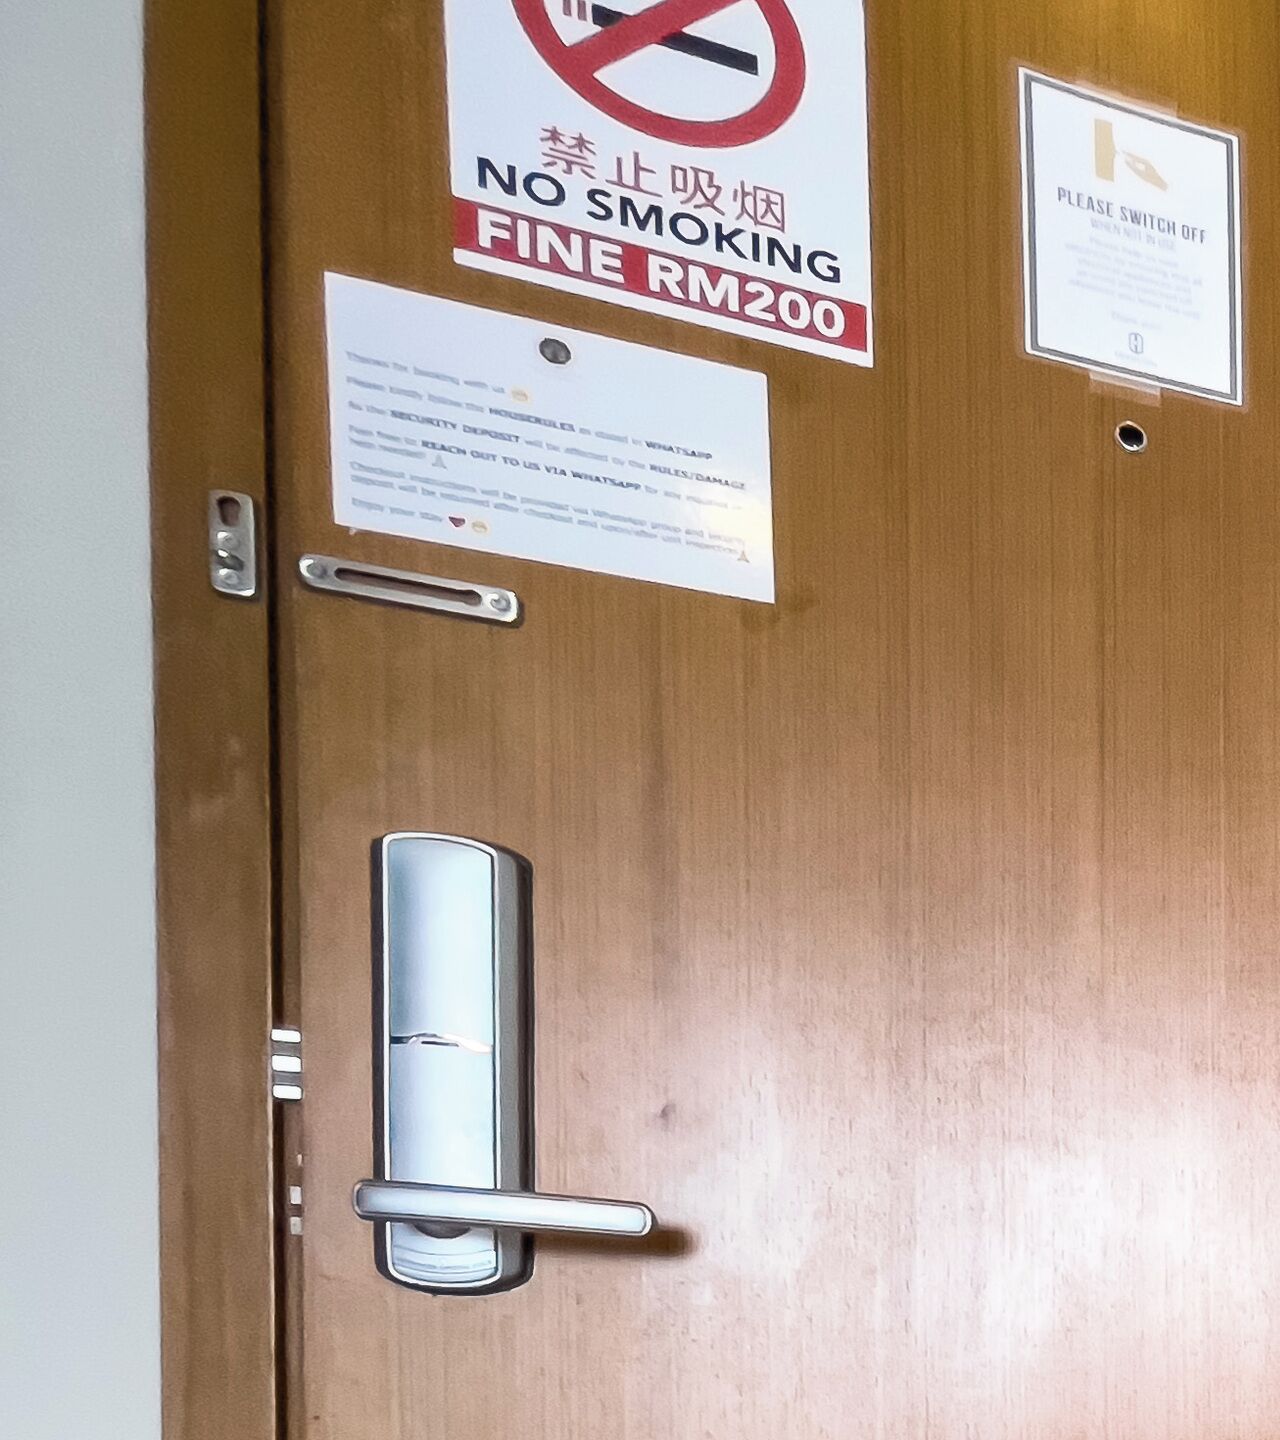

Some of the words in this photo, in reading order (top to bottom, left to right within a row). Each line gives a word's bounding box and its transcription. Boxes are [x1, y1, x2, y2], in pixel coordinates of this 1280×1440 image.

[476, 156, 567, 207] NO
[586, 188, 842, 284] SMOKING
[539, 126, 785, 235] 禁止吸烟
[1057, 186, 1113, 218] PLEASE
[1120, 205, 1175, 236] SWITCH
[1181, 222, 1206, 245] OFF
[476, 206, 626, 285] FINE
[646, 252, 846, 339] RM200
[470, 449, 497, 462] OUT
[502, 455, 519, 467] TO
[545, 464, 566, 476] VIA
